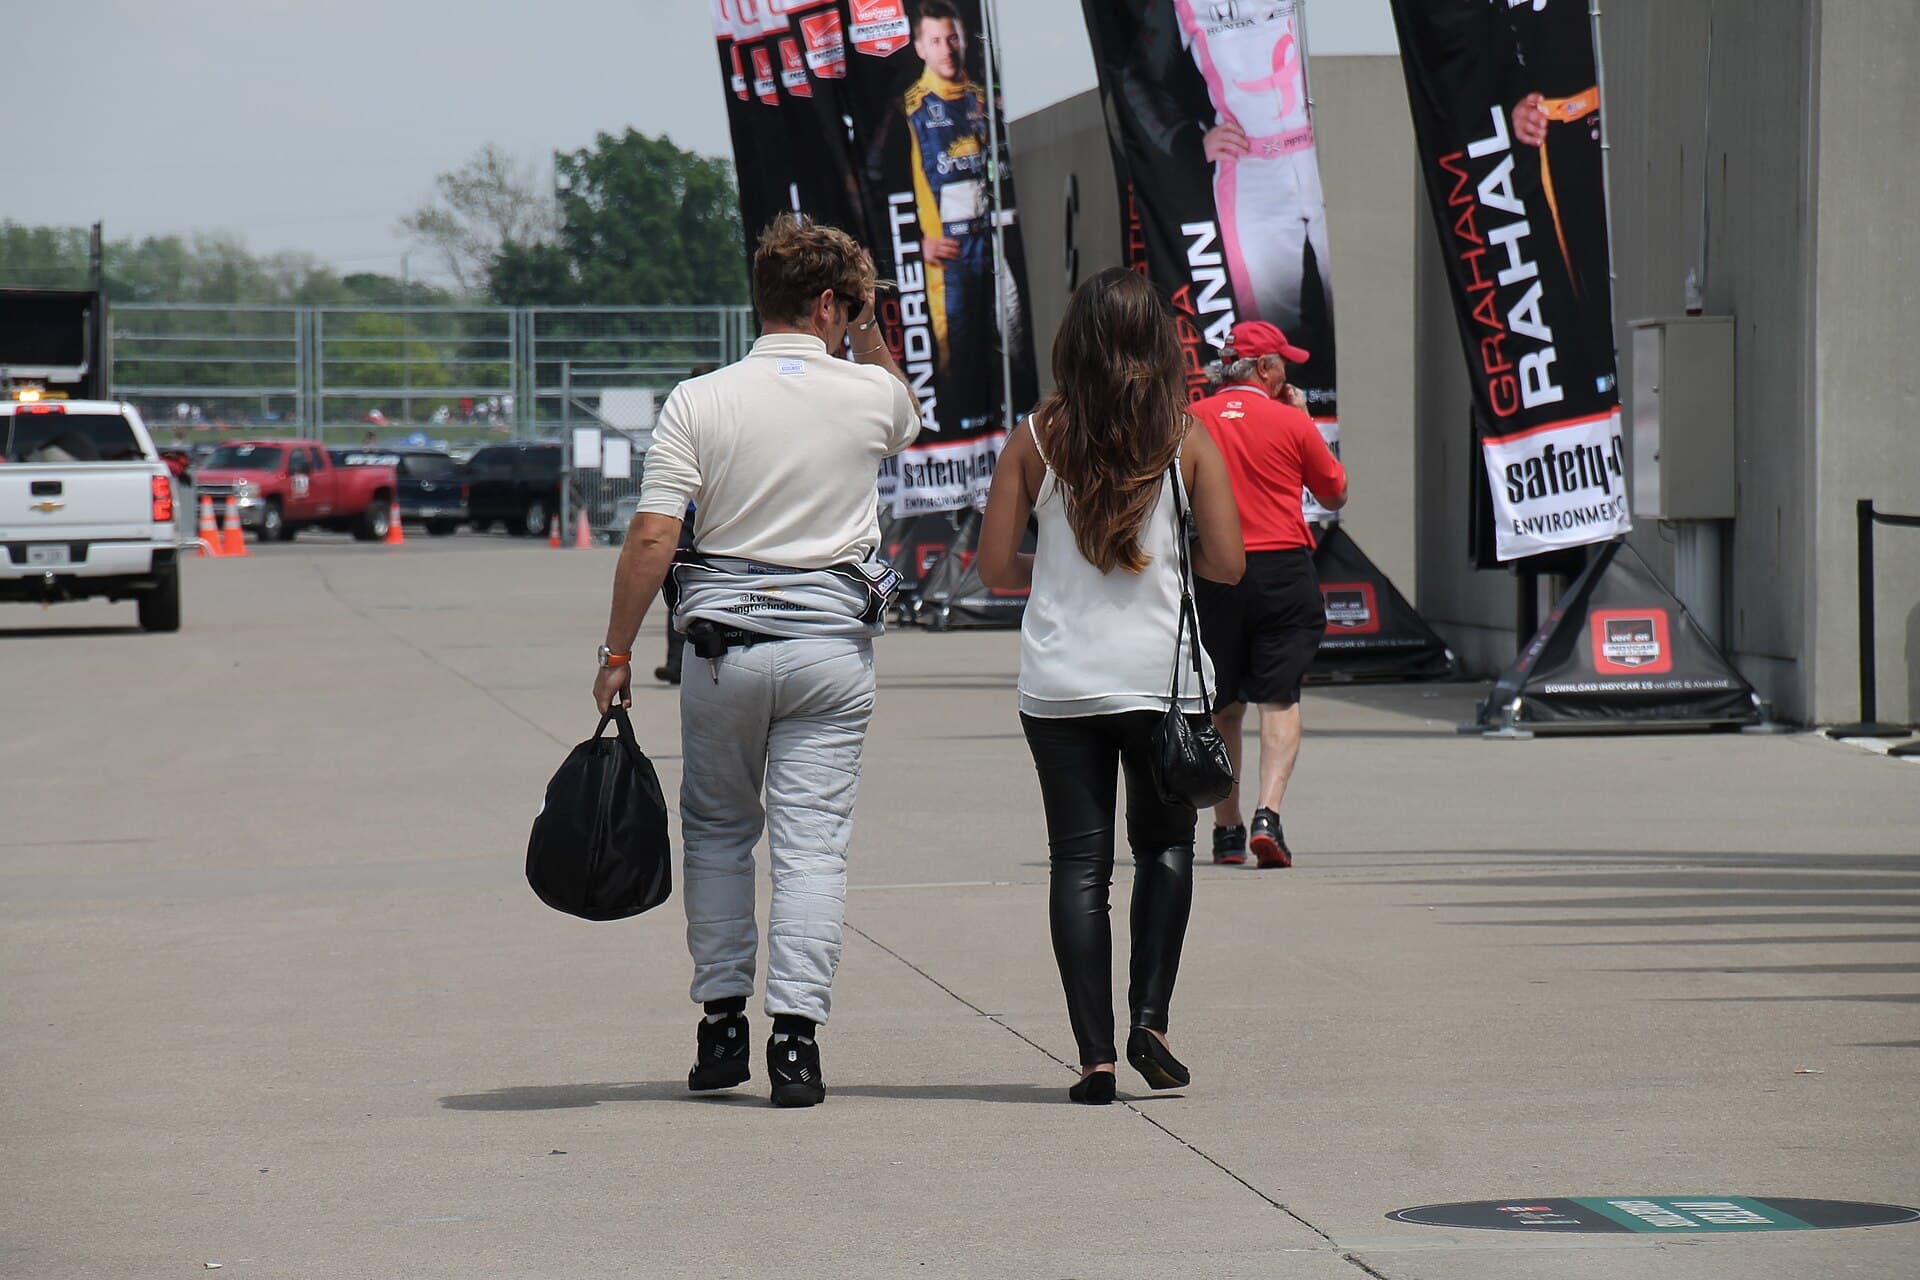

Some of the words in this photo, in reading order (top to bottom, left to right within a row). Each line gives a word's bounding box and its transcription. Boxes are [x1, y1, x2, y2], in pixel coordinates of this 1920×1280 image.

[888, 191, 941, 433] ANDRETTI
[1181, 220, 1236, 354] ANN
[1439, 152, 1521, 417] GRAHAM
[1467, 104, 1564, 409] RAHAL
[1544, 683, 1598, 694] DOWNLOAD
[1599, 682, 1640, 692] INDYCAR
